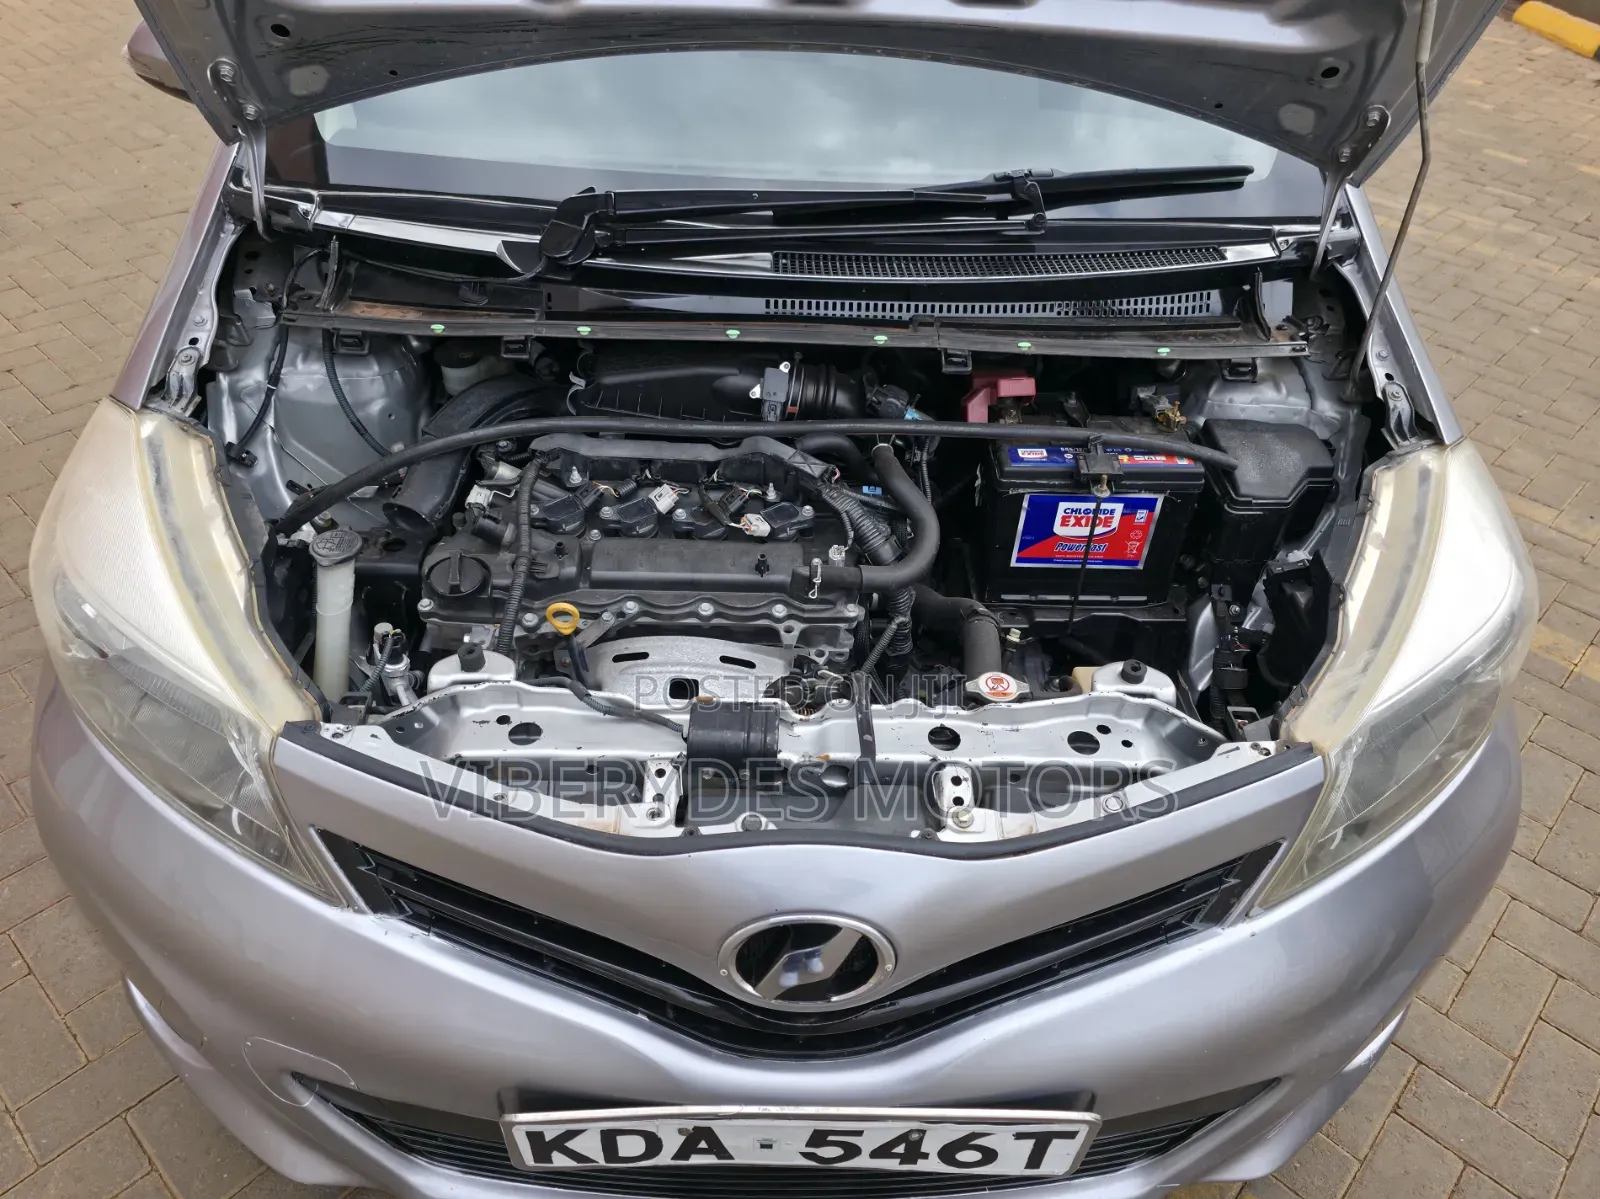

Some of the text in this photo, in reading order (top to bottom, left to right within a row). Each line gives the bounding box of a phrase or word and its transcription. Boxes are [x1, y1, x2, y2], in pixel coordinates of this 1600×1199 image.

[1053, 541, 1109, 552] Powerast
[526, 1125, 1078, 1171] KDA 546T
